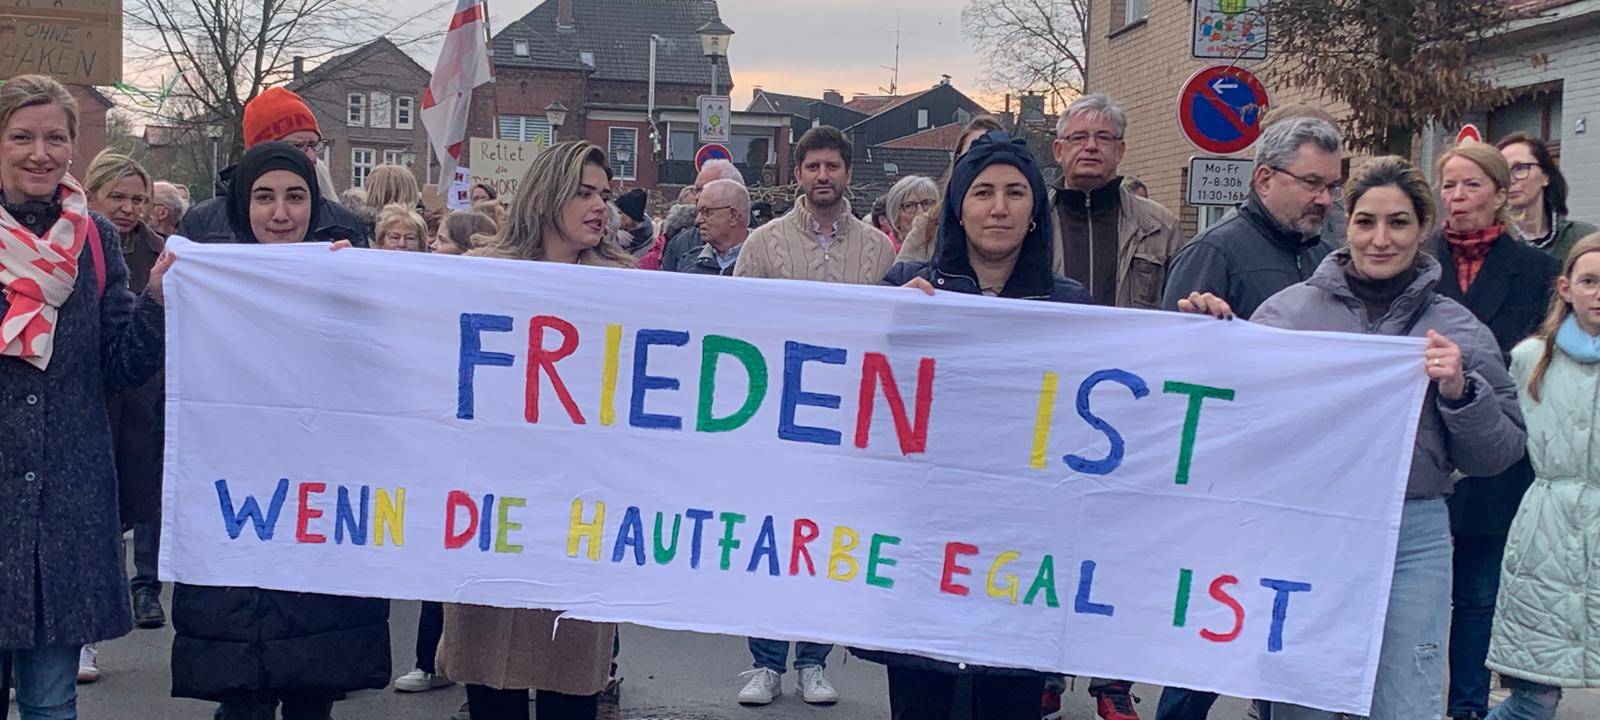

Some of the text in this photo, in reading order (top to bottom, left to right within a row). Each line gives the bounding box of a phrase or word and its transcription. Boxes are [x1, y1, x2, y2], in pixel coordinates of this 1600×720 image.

[24, 23, 78, 43] OHNE
[1, 42, 96, 78] HAKEN
[481, 141, 524, 161] Rettet
[1205, 164, 1239, 173] Mo-Fr
[456, 312, 1237, 486] FRIEDEN IST
[213, 477, 1313, 654] WENN DIE HAUTFARBE EGAL IST
